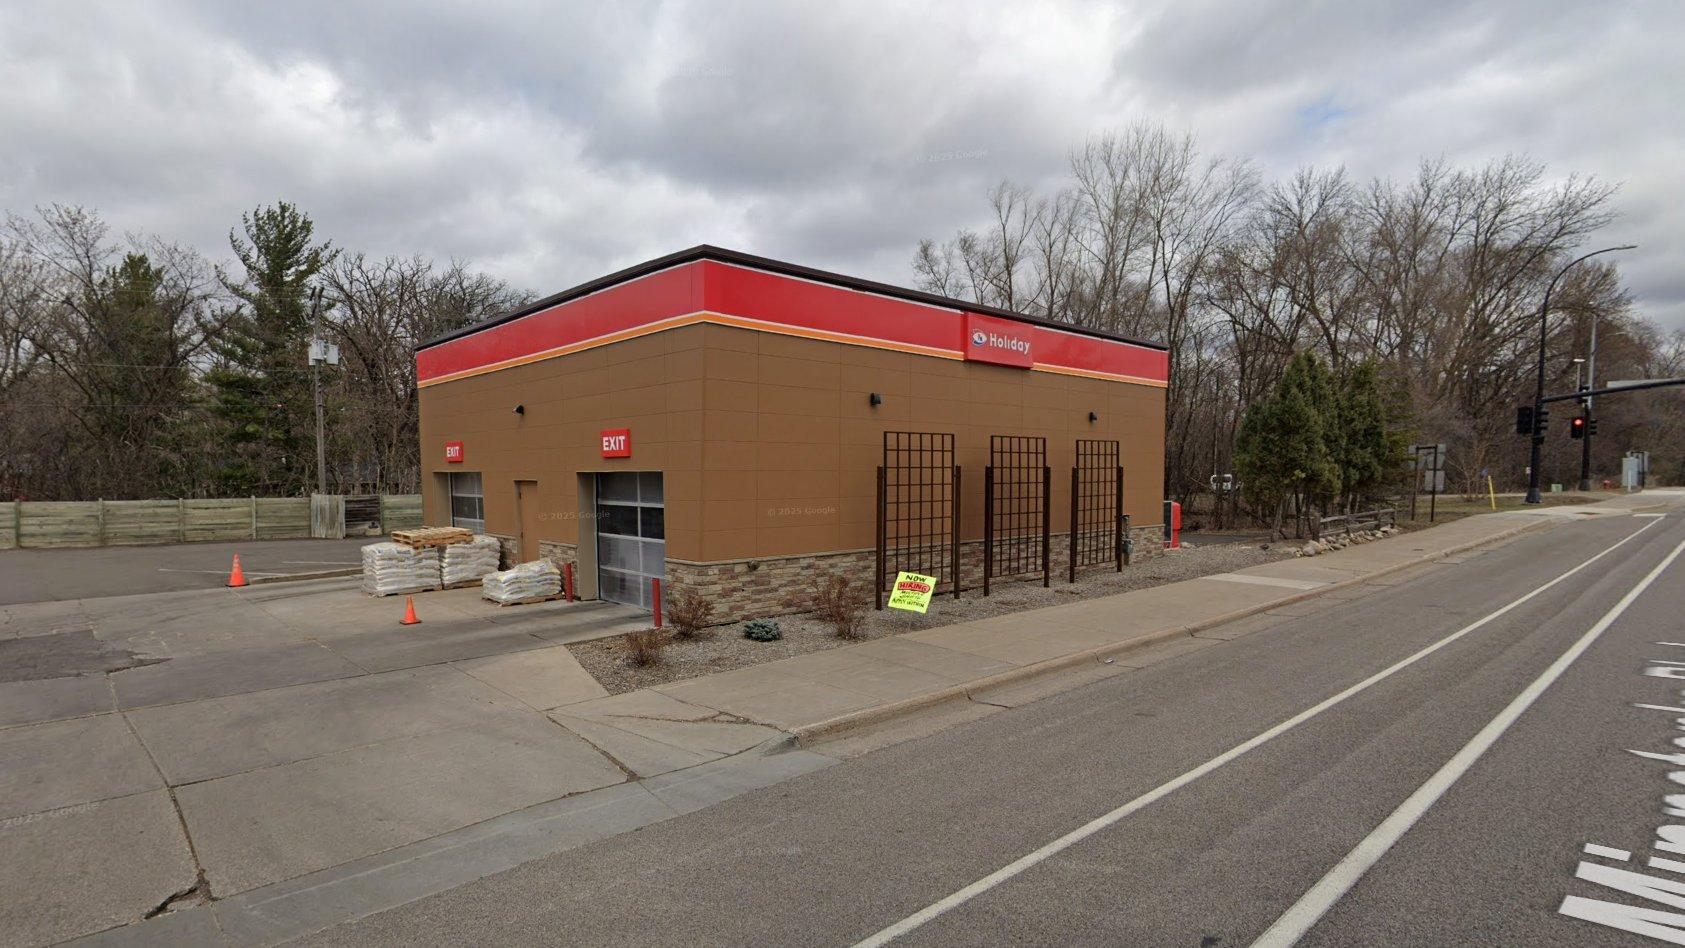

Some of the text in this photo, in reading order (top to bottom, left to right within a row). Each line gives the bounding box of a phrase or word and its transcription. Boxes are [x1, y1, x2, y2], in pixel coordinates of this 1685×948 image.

[989, 332, 1030, 355] Holiday
[602, 435, 626, 451] EXIT
[446, 446, 460, 457] EXIT
[905, 574, 927, 583] NOW
